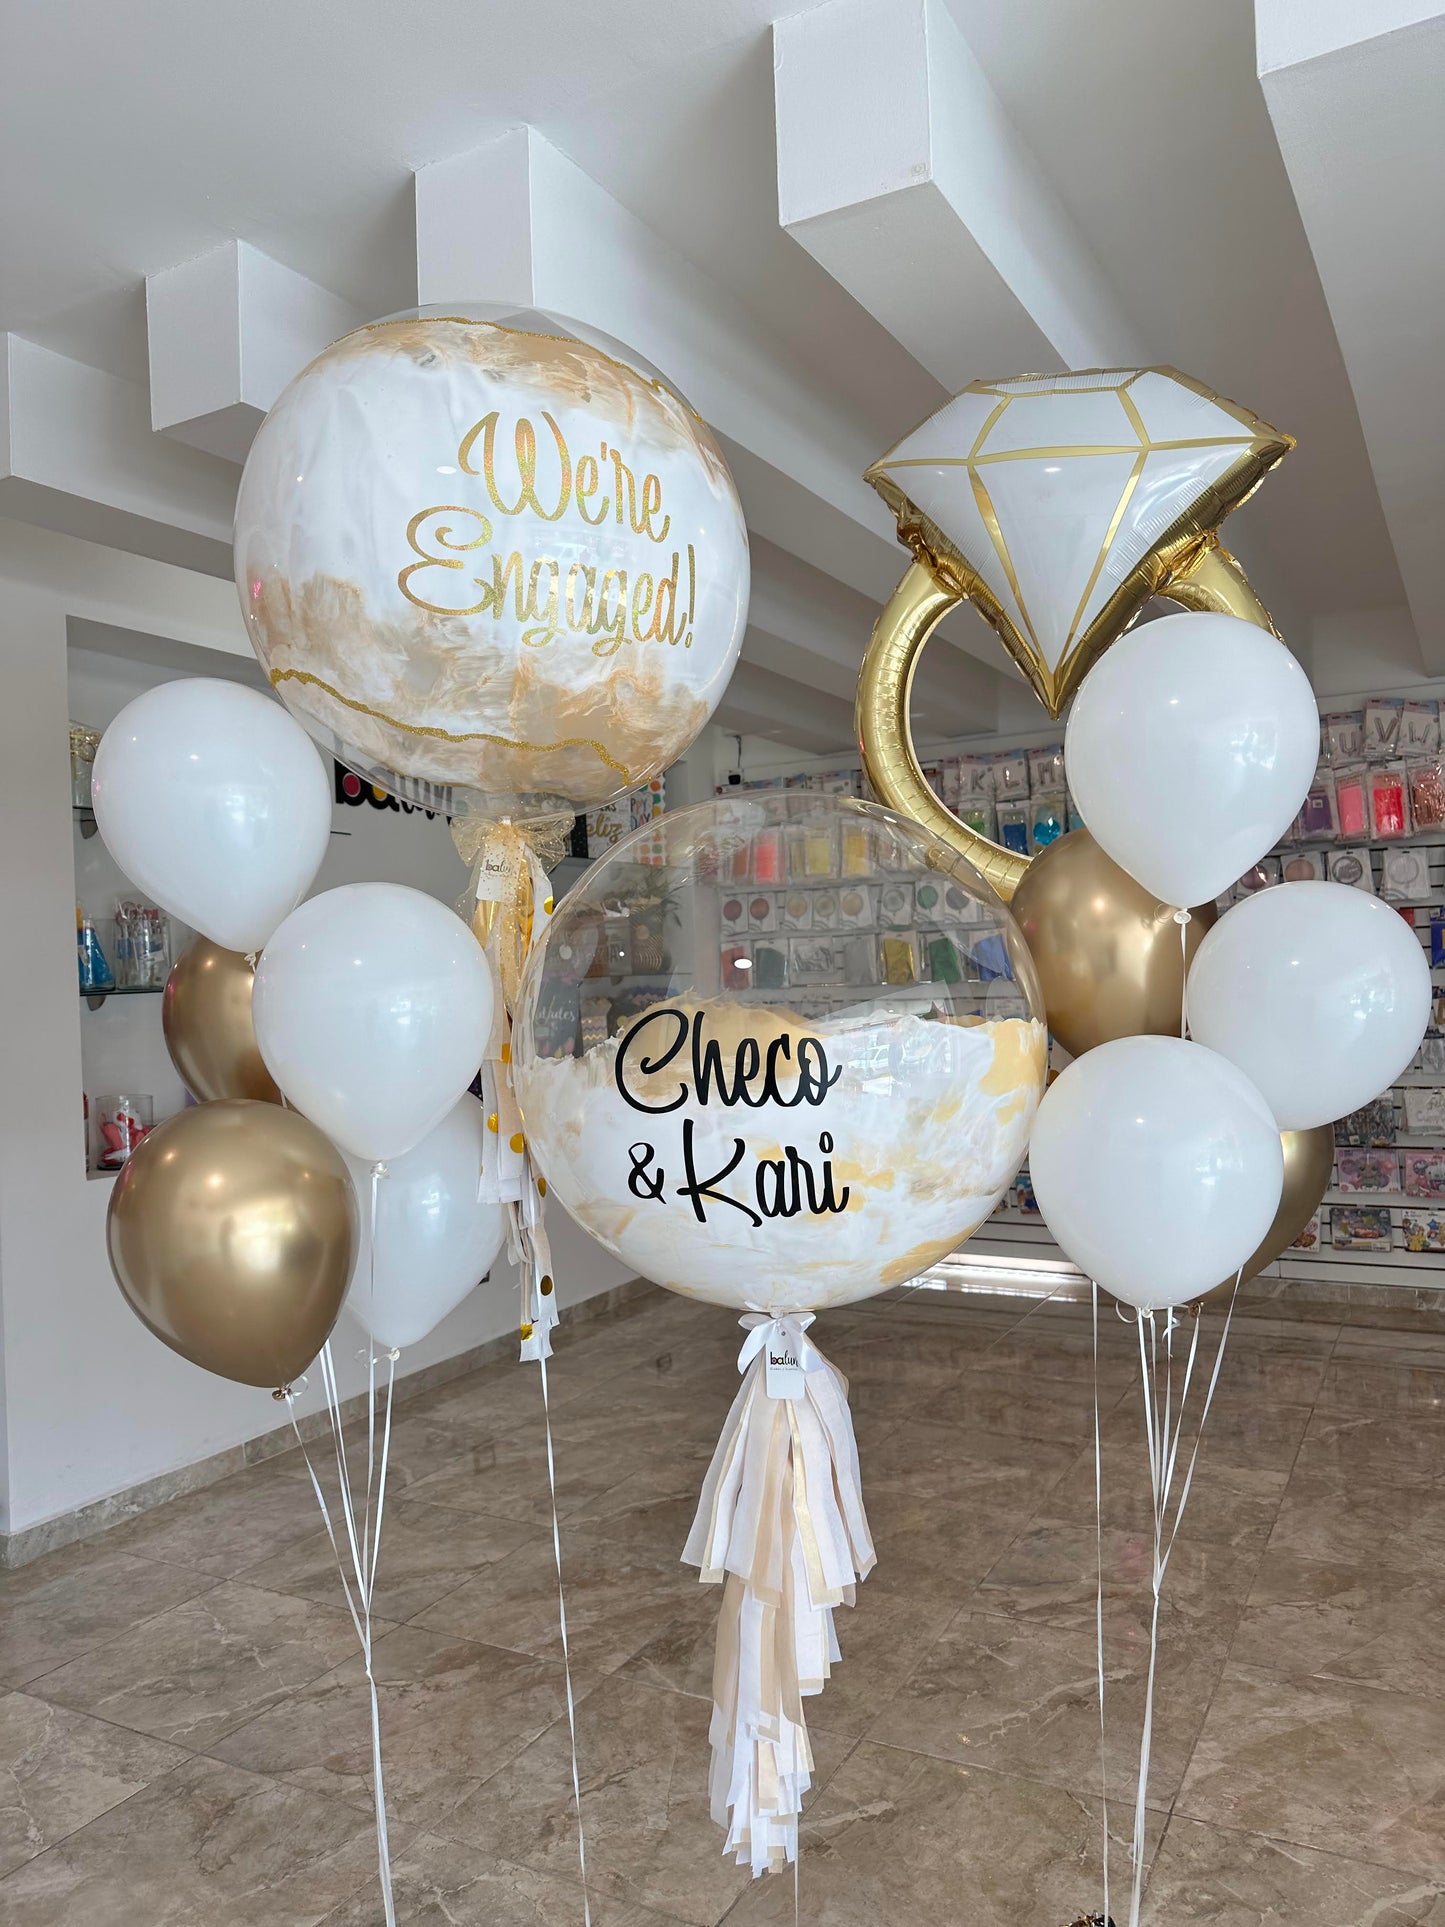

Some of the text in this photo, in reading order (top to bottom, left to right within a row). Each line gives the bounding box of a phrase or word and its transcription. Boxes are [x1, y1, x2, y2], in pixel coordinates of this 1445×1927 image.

[457, 410, 671, 544] We're
[397, 504, 696, 658] Engaged!
[615, 1008, 843, 1114] Checo
[677, 1118, 850, 1228] Kari
